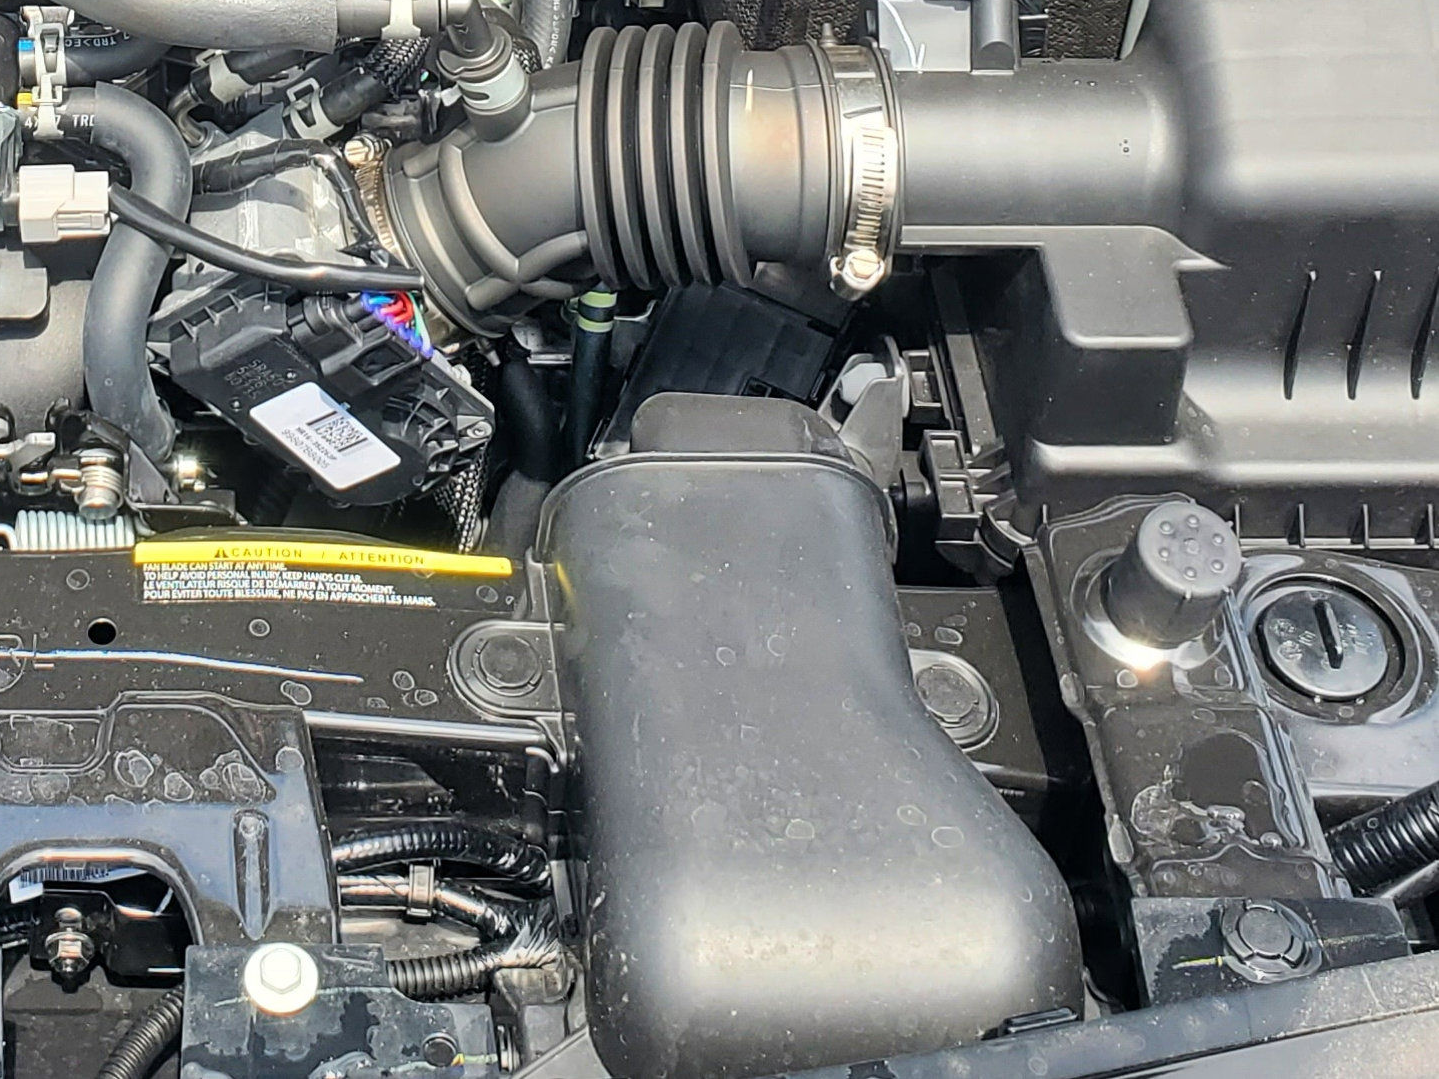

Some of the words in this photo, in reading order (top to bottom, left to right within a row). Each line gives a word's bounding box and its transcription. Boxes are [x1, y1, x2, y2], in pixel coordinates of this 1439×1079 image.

[231, 548, 303, 558] CAUTION
[339, 552, 425, 564] ATTENTION
[143, 563, 160, 571] FAN
[161, 563, 189, 571] BLADE
[189, 563, 207, 571] CAN
[208, 563, 234, 571] START
[235, 563, 246, 571] AT
[247, 563, 264, 571] ANY
[144, 572, 157, 580] TO
[157, 572, 179, 580] HELP
[180, 572, 206, 580] AVOID
[207, 572, 250, 580] PERSONAL
[282, 572, 304, 581] KEEP
[304, 573, 333, 582] HANDS
[143, 581, 154, 589] LE
[155, 581, 216, 589] VENTILATEUR
[217, 581, 252, 589] RISQUE
[253, 581, 265, 589] DE
[326, 583, 350, 592] TOUT
[143, 590, 170, 599] POUR
[171, 588, 203, 599] ÉVITER
[203, 590, 234, 599] TOUTE
[282, 591, 298, 600] NE
[298, 591, 315, 601] PAS
[316, 592, 329, 601] EN
[329, 592, 385, 604] APPROCHER
[385, 595, 402, 605] LES
